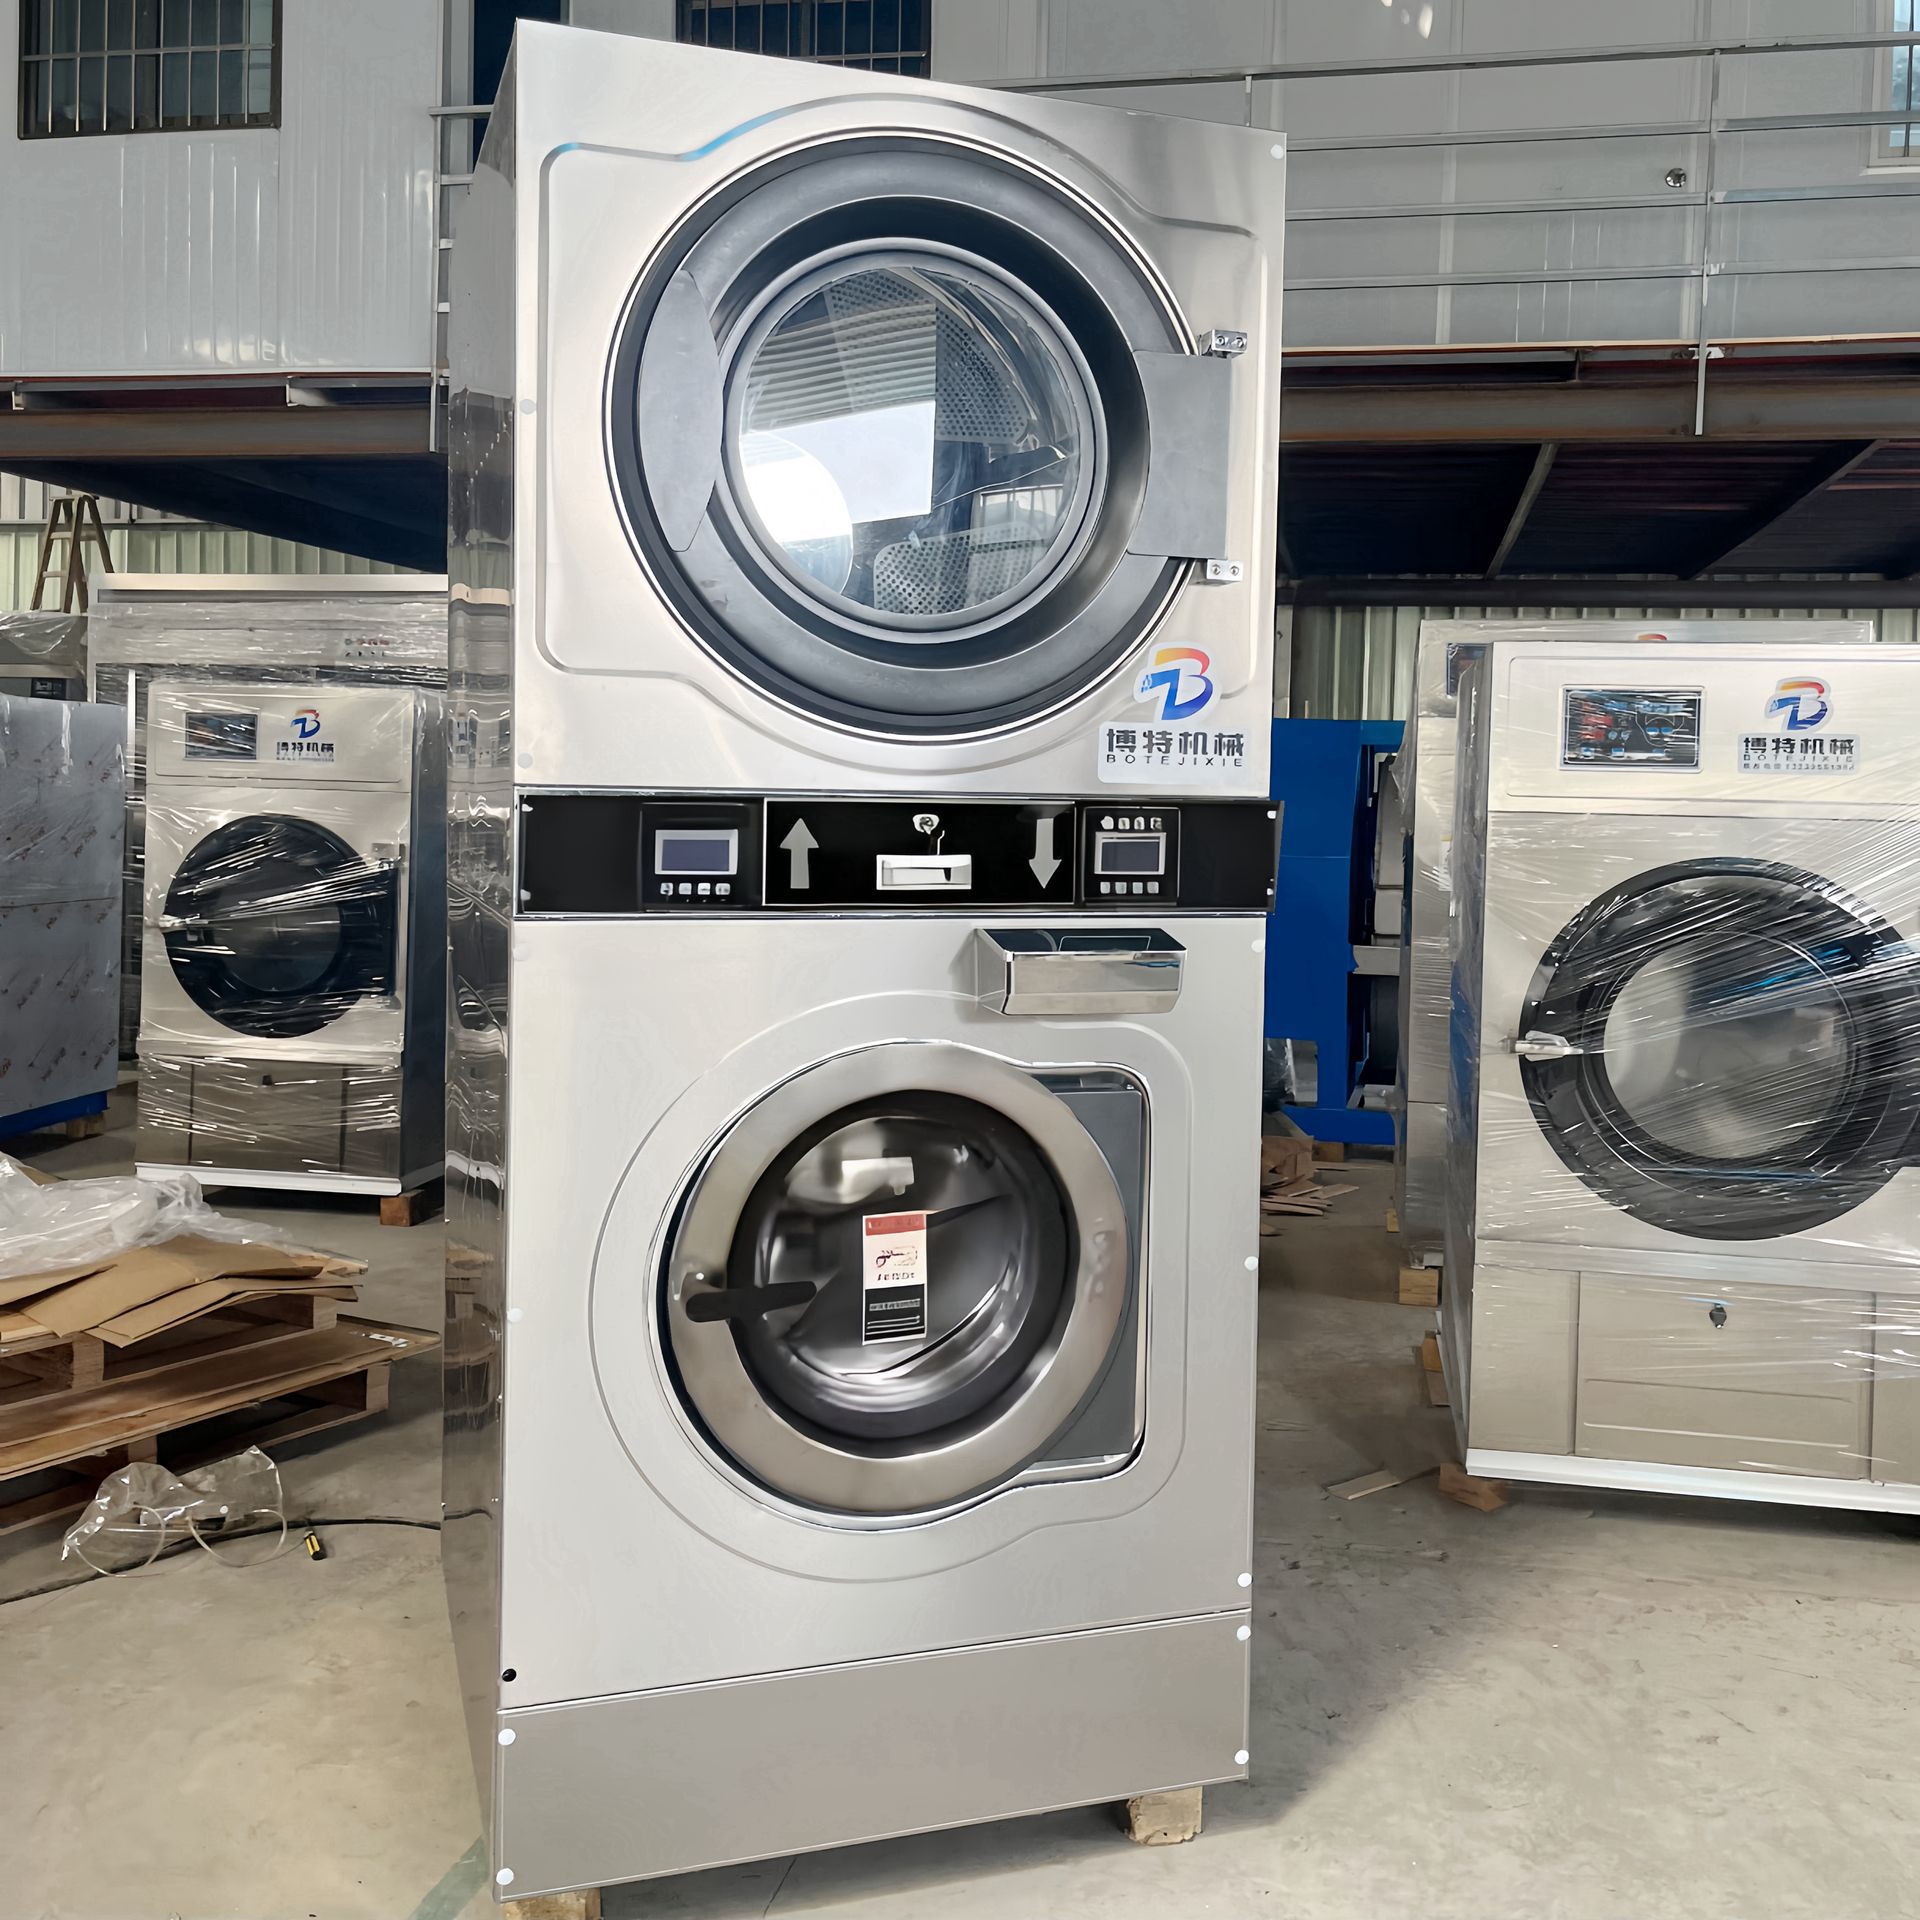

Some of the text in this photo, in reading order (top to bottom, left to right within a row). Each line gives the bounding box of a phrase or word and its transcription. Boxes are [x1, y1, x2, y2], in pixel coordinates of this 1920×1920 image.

[1107, 729, 1244, 757] 博特机械
[1743, 737, 1855, 755] 博特机械
[1106, 754, 1243, 767] BOTEJIXIE
